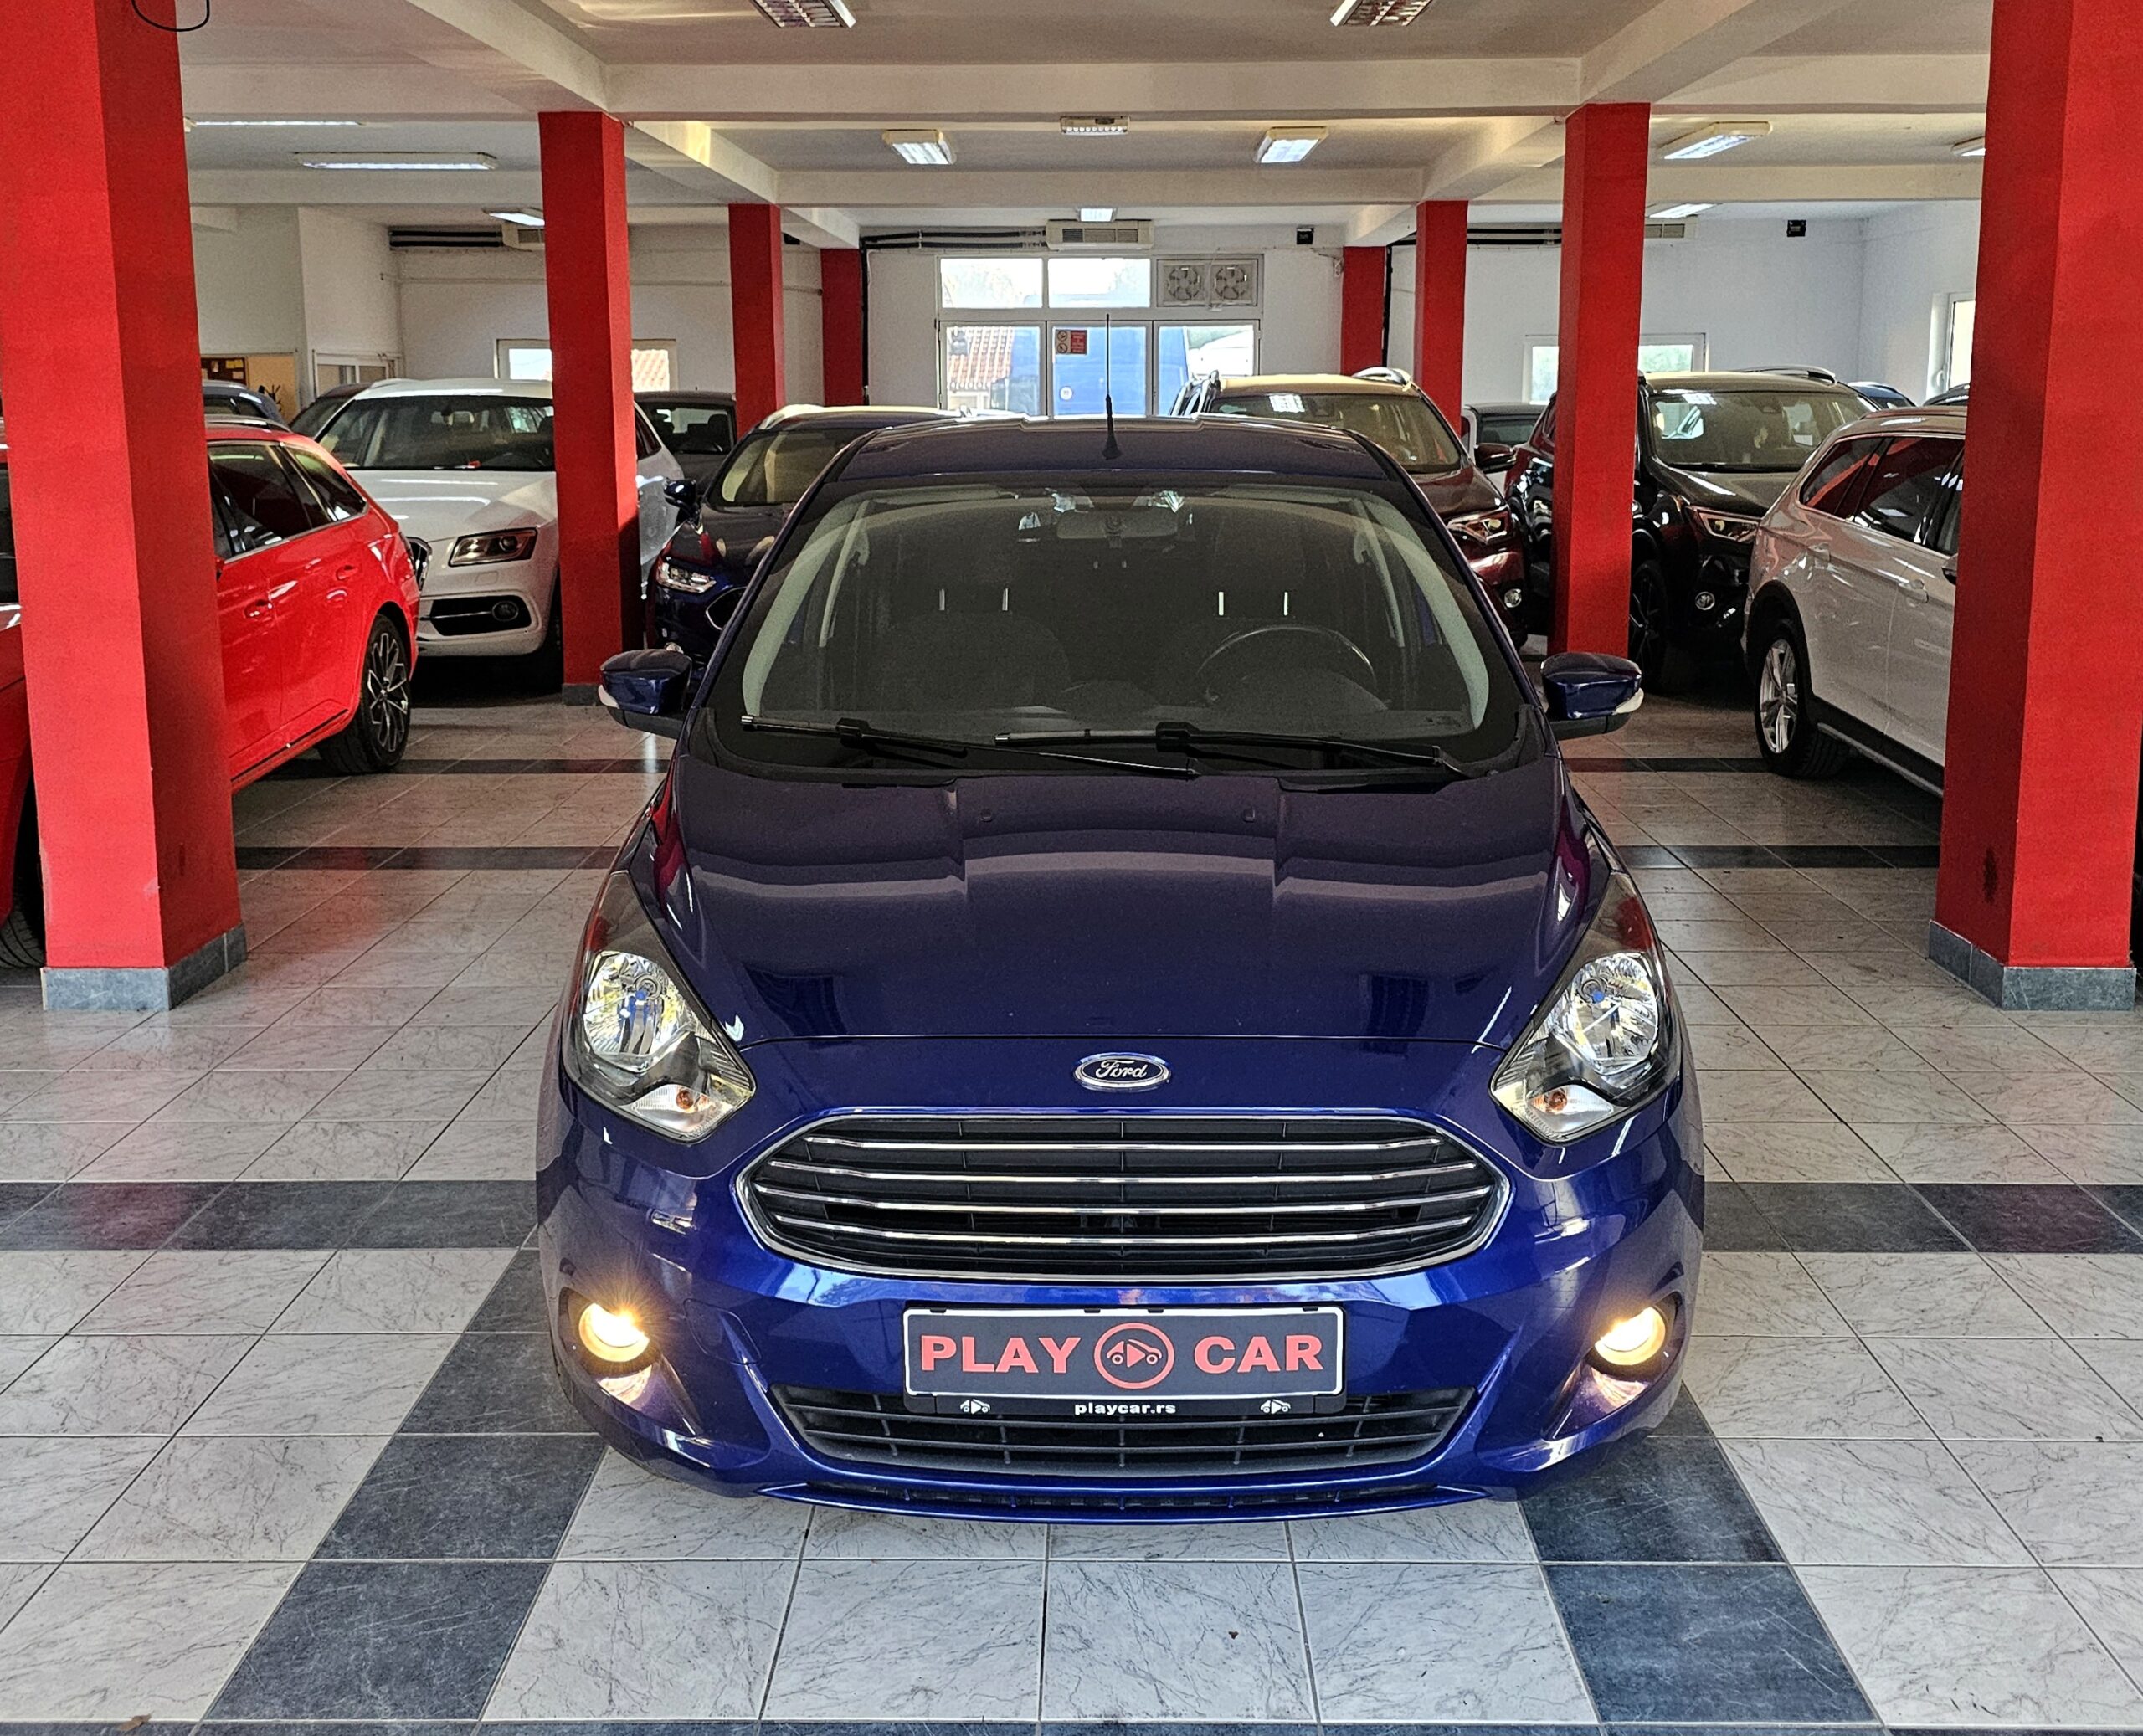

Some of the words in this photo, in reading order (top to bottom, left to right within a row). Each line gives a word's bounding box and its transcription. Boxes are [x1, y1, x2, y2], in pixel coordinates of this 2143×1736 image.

[1095, 1060, 1149, 1078] Ford
[921, 1335, 1081, 1374] PLAY
[1194, 1335, 1323, 1374] CAR
[1074, 1402, 1177, 1415] playcar.rs
